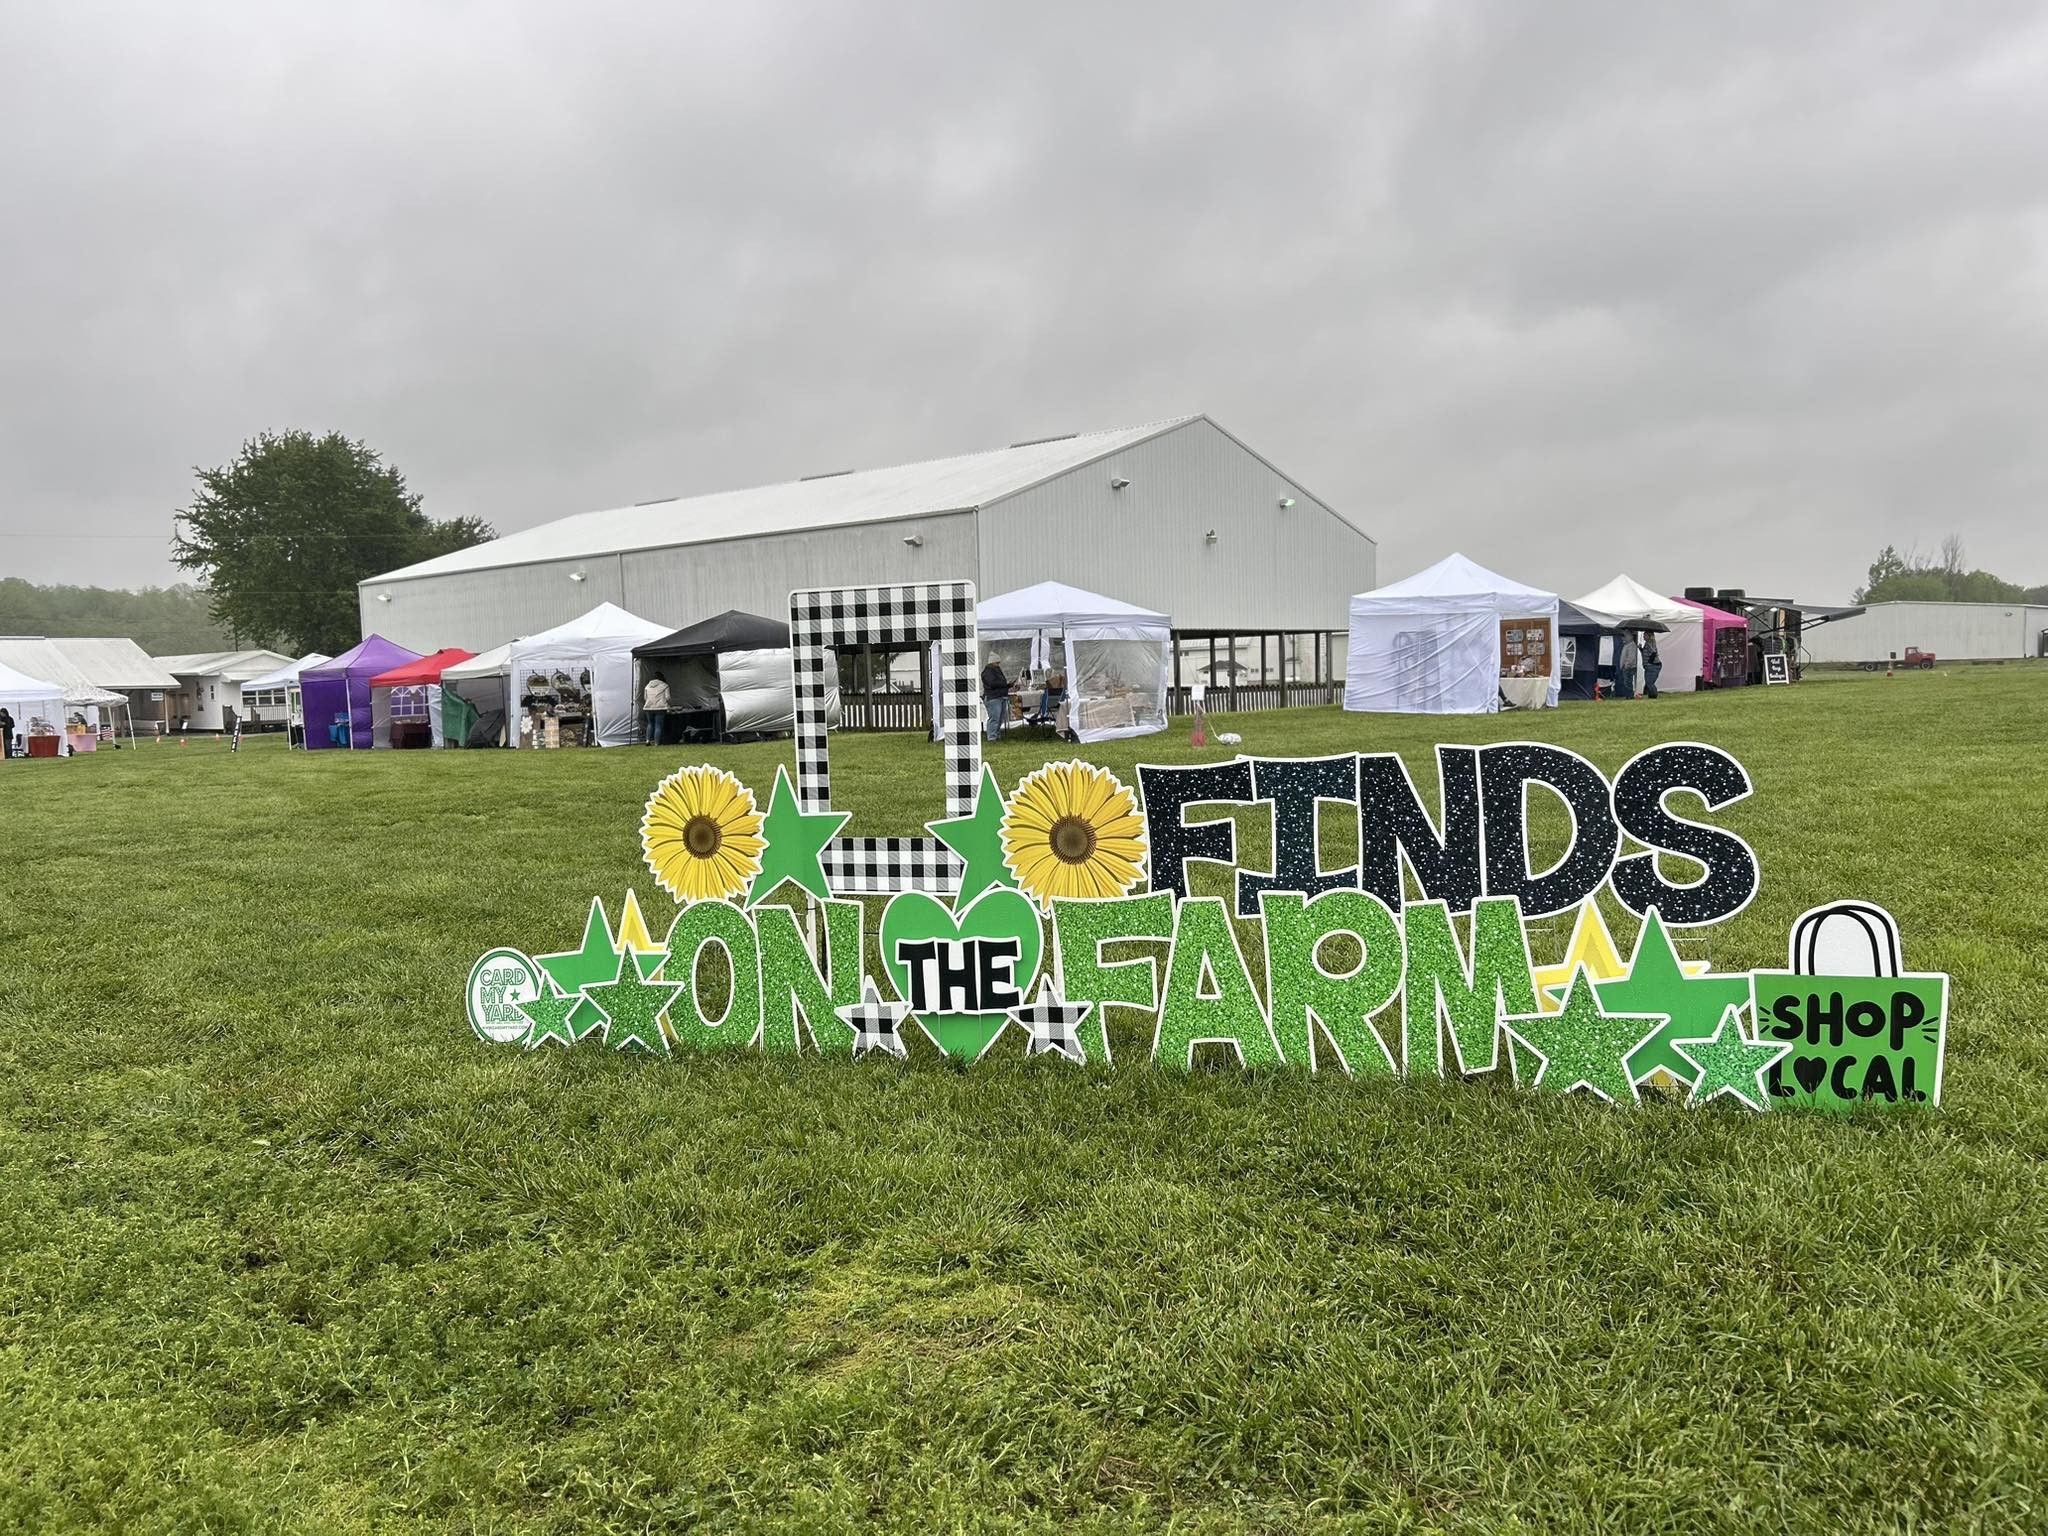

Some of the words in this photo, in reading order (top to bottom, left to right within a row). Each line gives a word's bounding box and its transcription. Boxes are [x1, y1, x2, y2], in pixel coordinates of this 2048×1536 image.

[1138, 742, 1760, 925] FINDS
[480, 968, 526, 986] CARD
[480, 987, 506, 1004] MY
[662, 898, 863, 1052] ON
[899, 940, 1021, 1012] THE
[1052, 889, 1542, 1080] FARM
[1771, 991, 1926, 1051] SHOP
